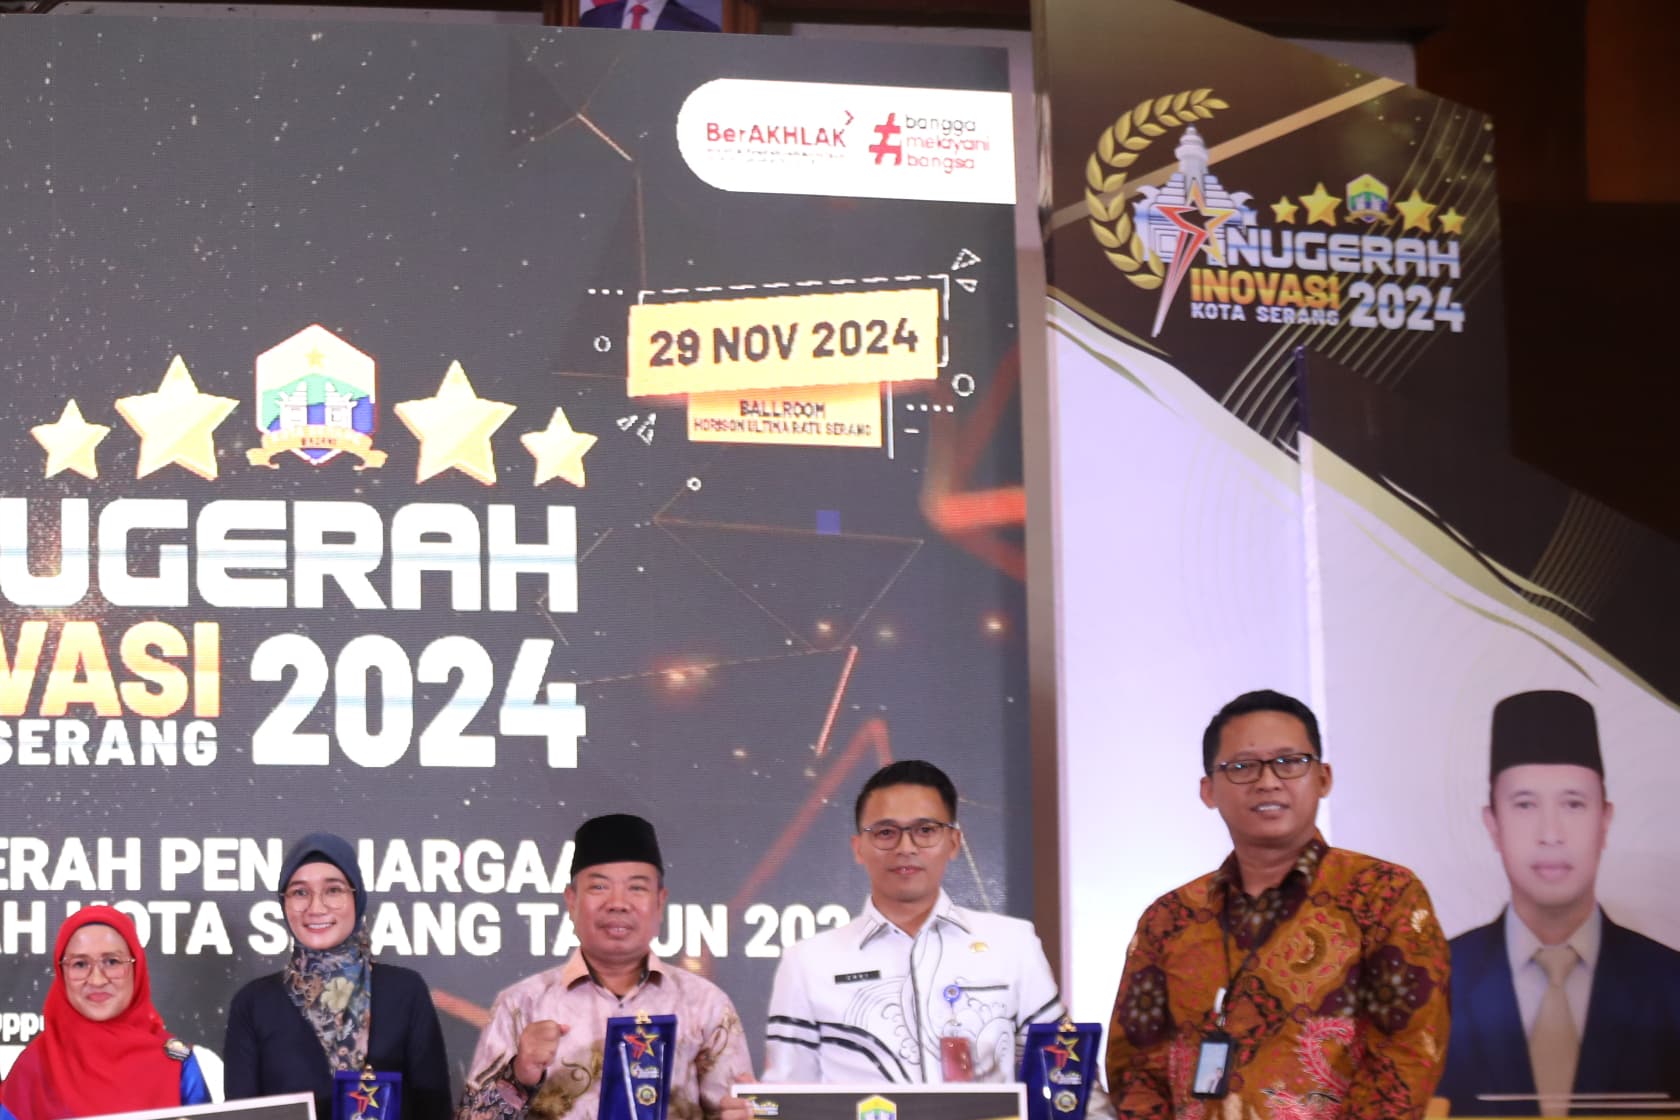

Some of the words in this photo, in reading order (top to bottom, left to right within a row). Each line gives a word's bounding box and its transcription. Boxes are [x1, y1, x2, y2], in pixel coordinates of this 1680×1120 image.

[707, 122, 846, 148] BerAKHLAK
[905, 114, 976, 136] bangga
[907, 153, 975, 174] bangsa
[1191, 269, 1340, 309] INOVASI
[1191, 303, 1246, 322] KOTA
[1256, 305, 1340, 326] SERANG
[1349, 281, 1465, 333] 2024
[650, 329, 700, 366] 29
[713, 322, 799, 363] NOV
[812, 318, 919, 357] 2024
[740, 399, 826, 418] BALLROOM
[250, 633, 586, 769] 2024
[66, 901, 232, 955] OTA
[248, 901, 502, 957] SANG
[516, 902, 728, 958] TAUN
[744, 903, 851, 958] 20
